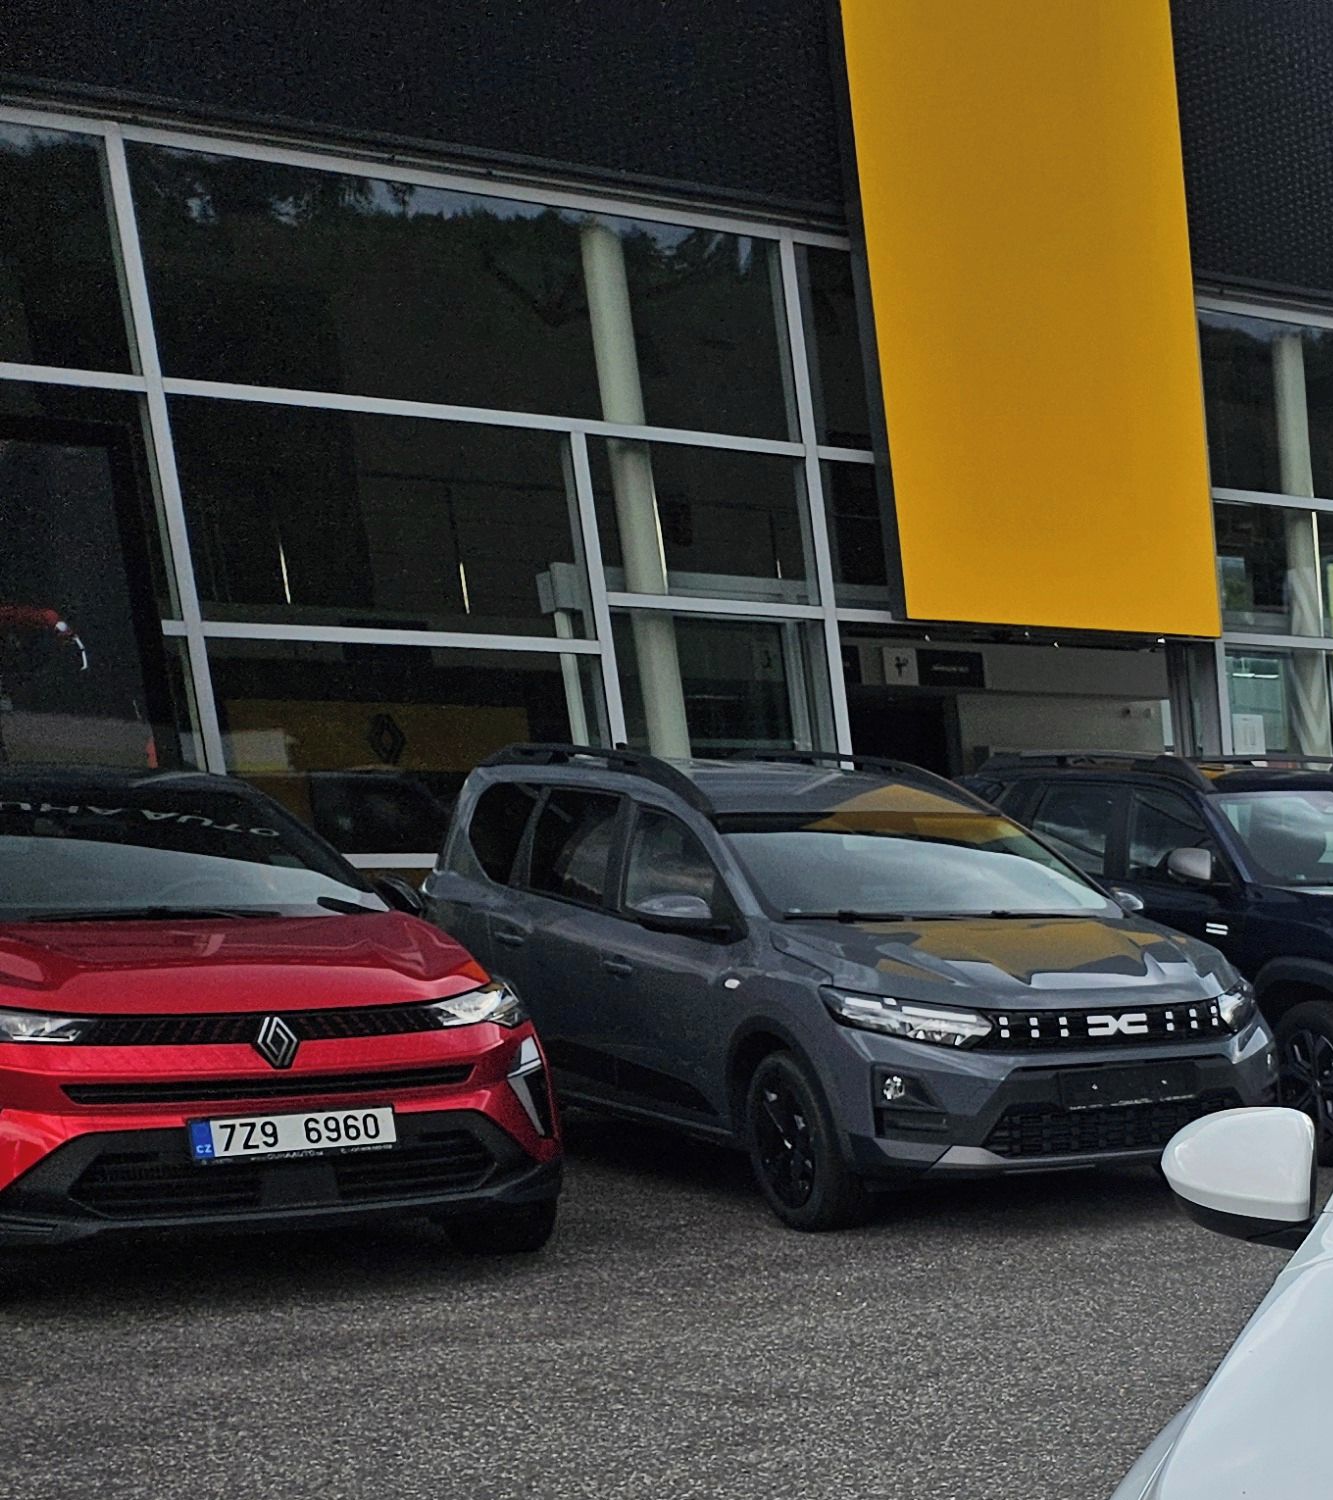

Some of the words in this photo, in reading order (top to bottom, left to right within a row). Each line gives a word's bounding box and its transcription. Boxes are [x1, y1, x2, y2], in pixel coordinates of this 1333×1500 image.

[219, 1121, 279, 1152] 7Z9
[304, 1113, 380, 1144] 6960
[196, 1143, 213, 1154] CZ
